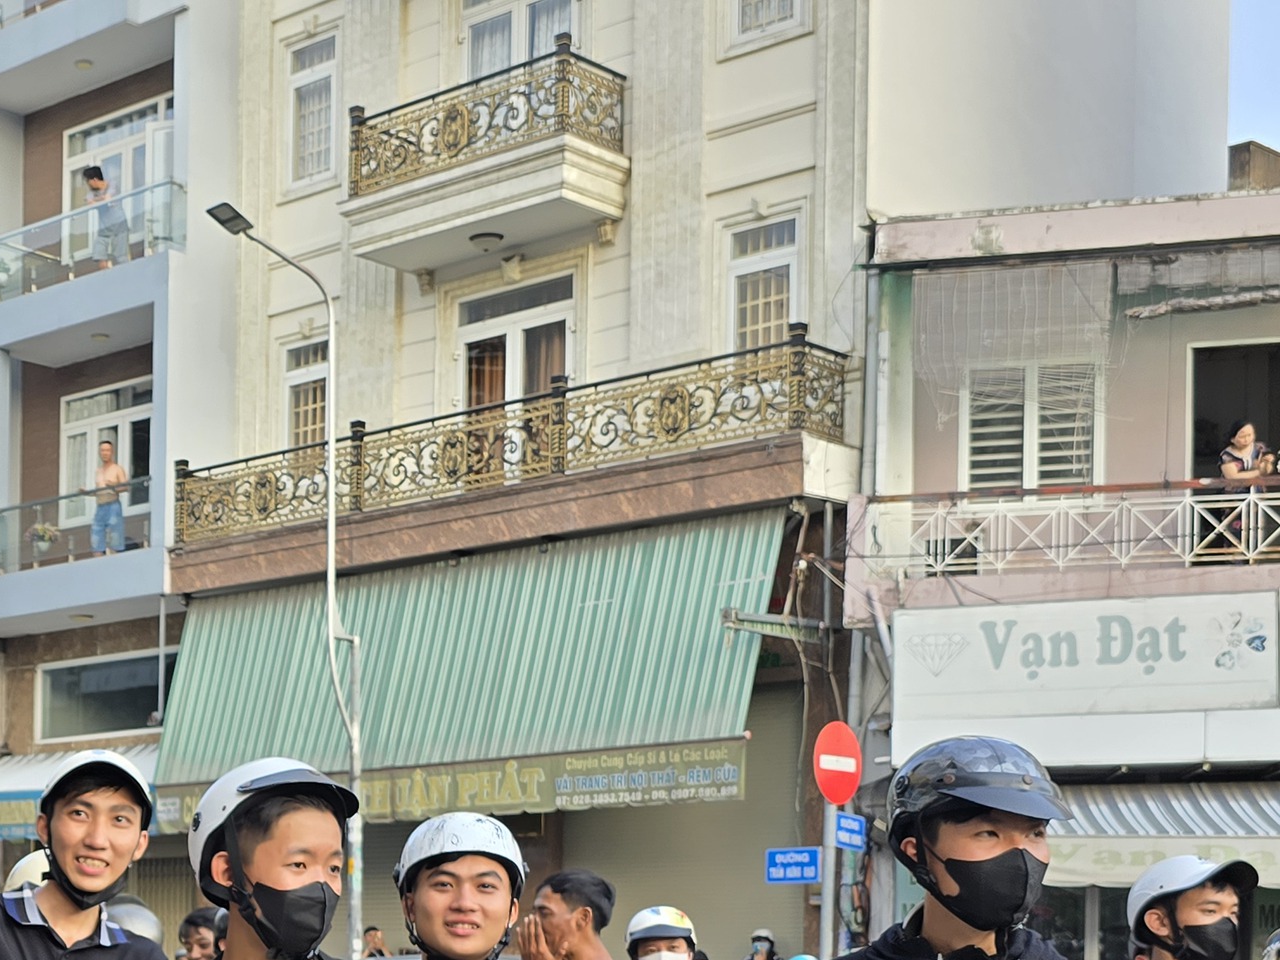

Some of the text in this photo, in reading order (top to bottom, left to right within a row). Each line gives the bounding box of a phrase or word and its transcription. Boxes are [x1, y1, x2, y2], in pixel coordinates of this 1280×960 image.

[978, 614, 1188, 681] Vạn Đạt
[565, 757, 599, 772] Chuyên
[600, 754, 625, 769] Cung
[626, 752, 645, 767] Cấp
[658, 752, 667, 764] &
[682, 748, 702, 762] Các
[574, 775, 608, 793] TRANG
[610, 770, 628, 790] TRÍ
[628, 769, 649, 791] NỘI
[649, 766, 677, 788] THẤT
[686, 764, 712, 786] RÈM
[713, 761, 738, 784] CỬA
